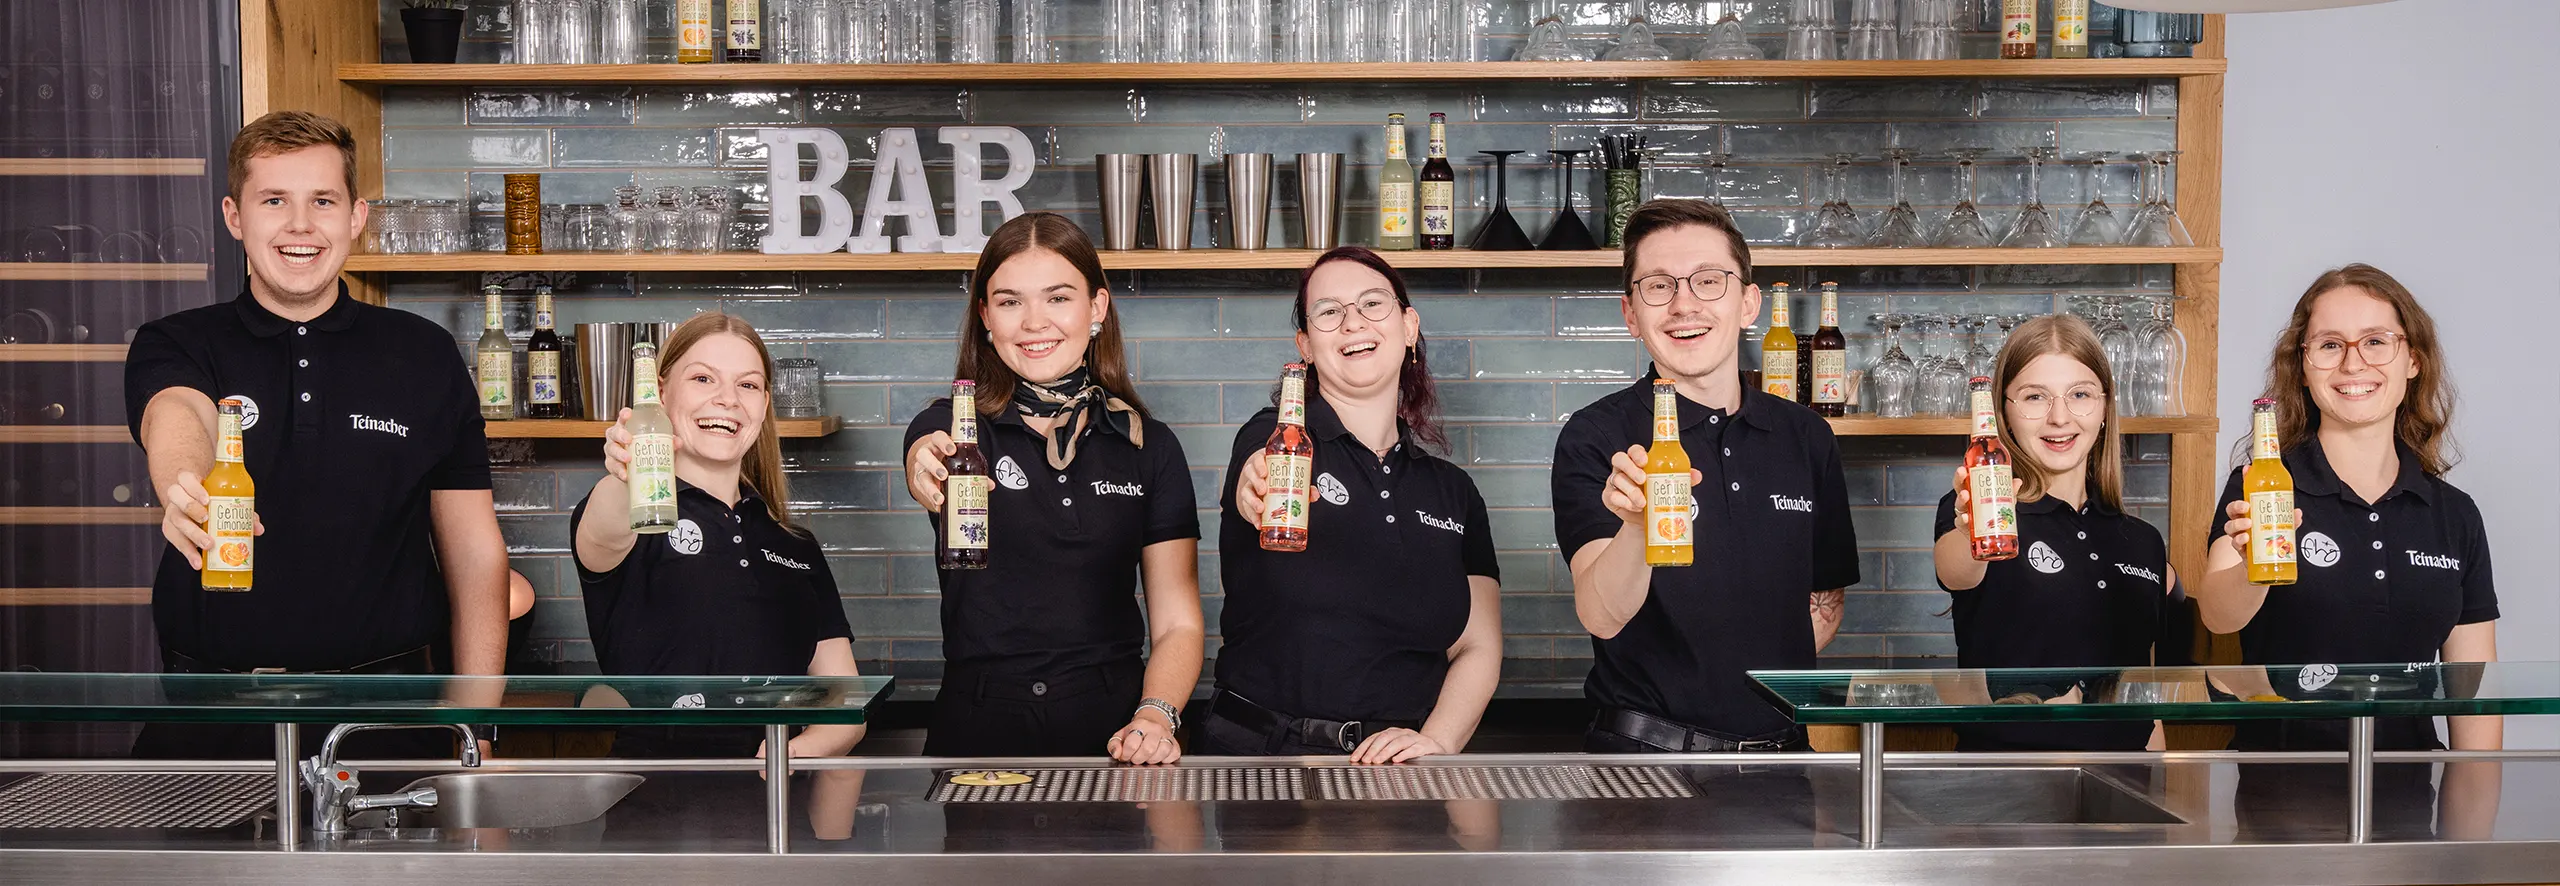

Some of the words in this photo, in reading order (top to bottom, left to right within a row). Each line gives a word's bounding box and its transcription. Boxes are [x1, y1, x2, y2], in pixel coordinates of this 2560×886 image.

[681, 0, 708, 12] Genss
[730, 0, 756, 12] Genss
[2057, 0, 2084, 8] Genss
[681, 12, 708, 20] Limoade
[757, 126, 1035, 254] BAR
[1382, 200, 1408, 208] Limonde
[349, 414, 409, 438] Teinacher
[634, 442, 671, 457] Genuss
[635, 456, 671, 467] Limonade
[957, 483, 988, 498] Genus
[1653, 480, 1689, 495] Genuss
[957, 497, 988, 509] Limonad
[1653, 494, 1689, 506] Limonade
[1769, 494, 1813, 513] Teinache
[216, 504, 253, 520] Genuss
[216, 519, 253, 531] Limonade
[1415, 510, 1465, 535] Teinacher
